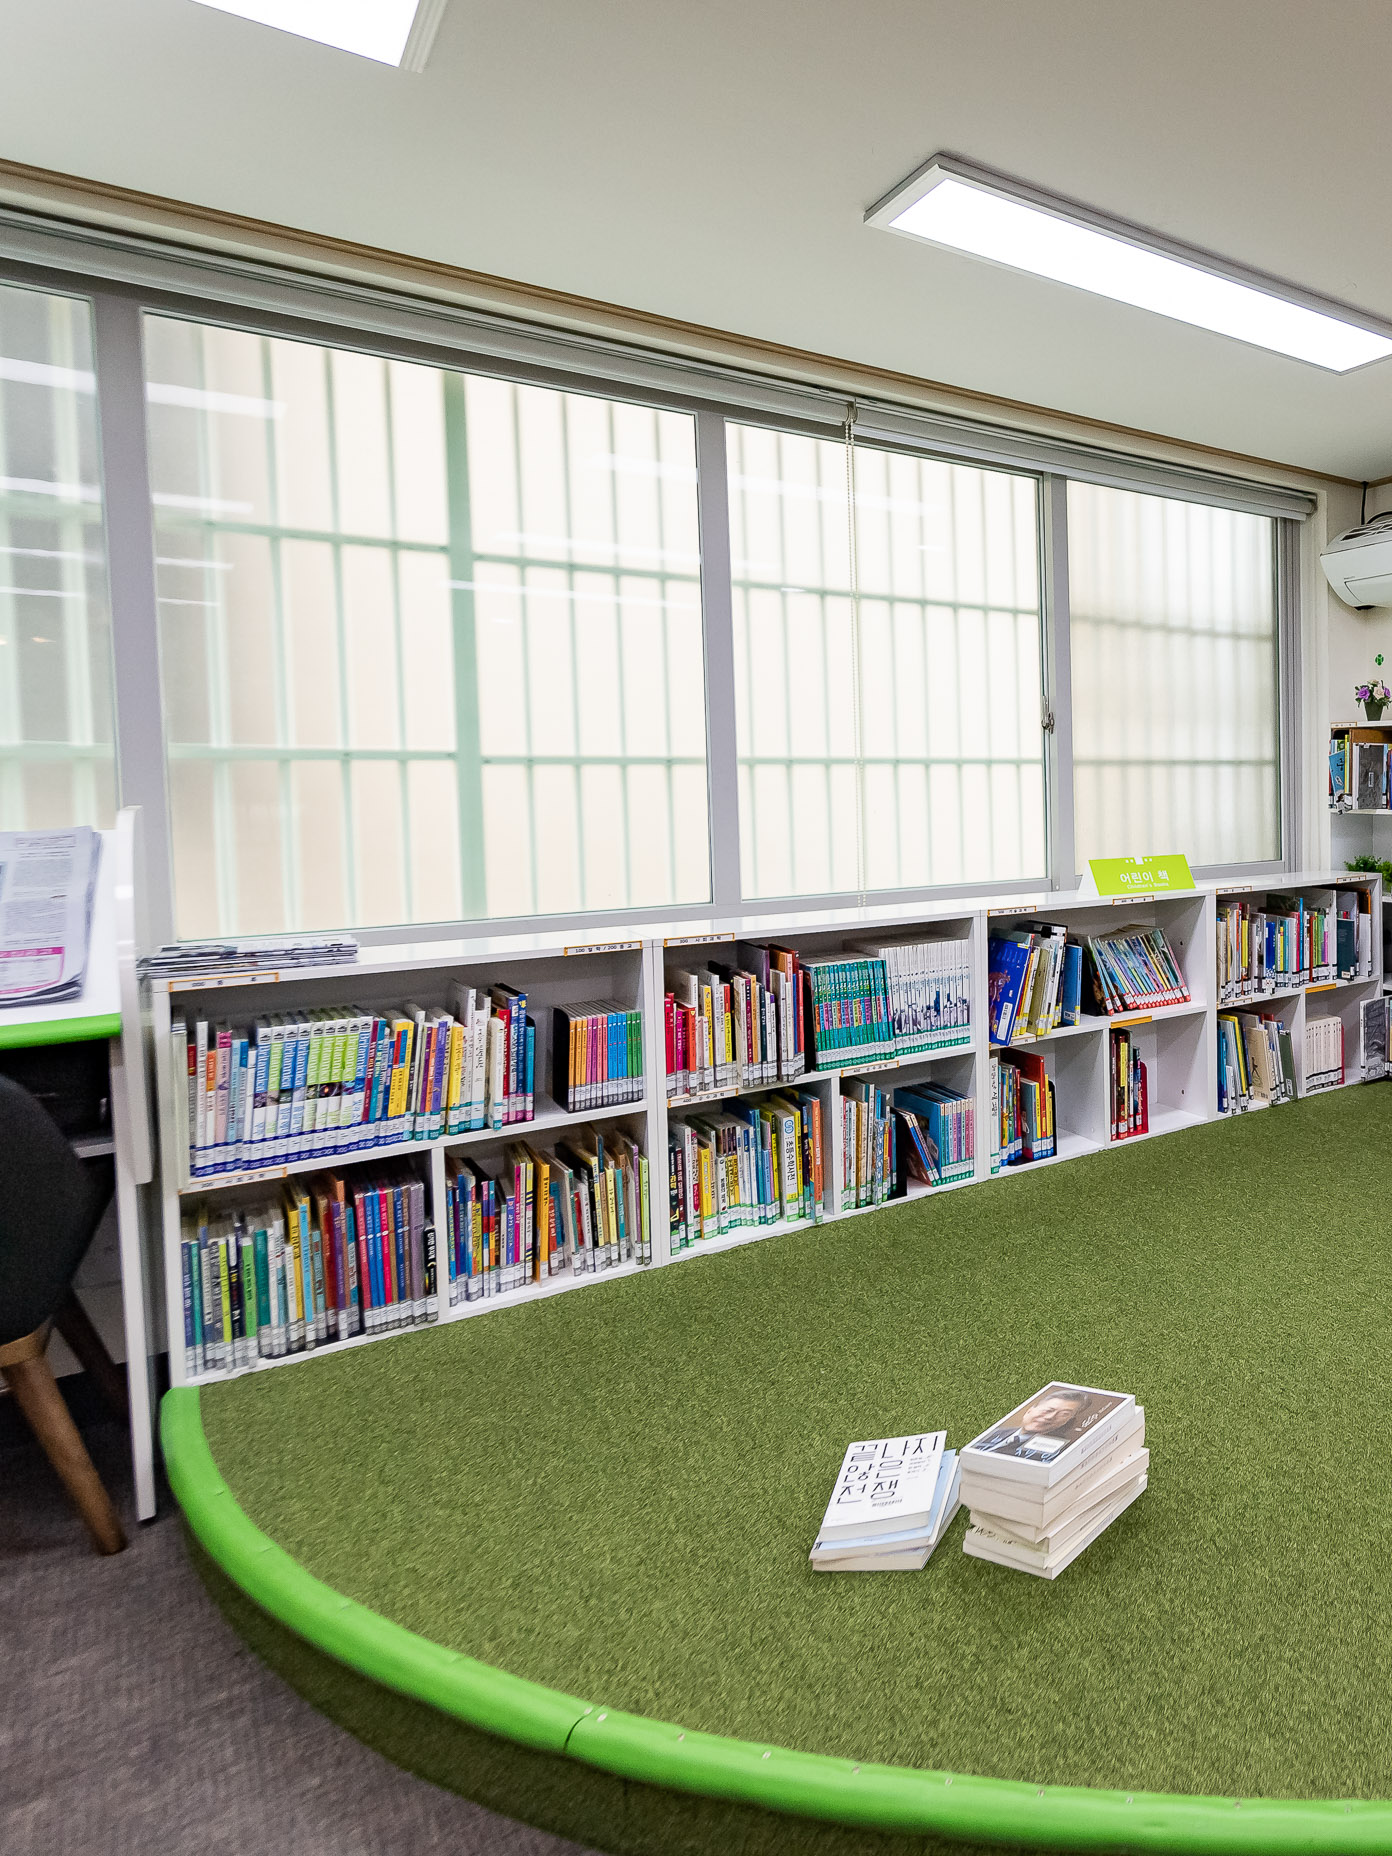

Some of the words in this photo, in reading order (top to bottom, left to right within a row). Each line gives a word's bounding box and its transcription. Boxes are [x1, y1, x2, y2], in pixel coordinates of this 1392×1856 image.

[1120, 871, 1154, 885] 어린이
[1158, 869, 1169, 882] 책
[256, 1044, 271, 1093] Britannica
[280, 1041, 296, 1089] Britannica
[294, 1040, 309, 1087] Britannica
[356, 1032, 371, 1078] Britannica
[785, 1140, 796, 1181] 초등수학사전
[850, 1435, 939, 1462] 끝나지
[843, 1459, 903, 1483] 않은
[836, 1479, 899, 1505] 전쟁
